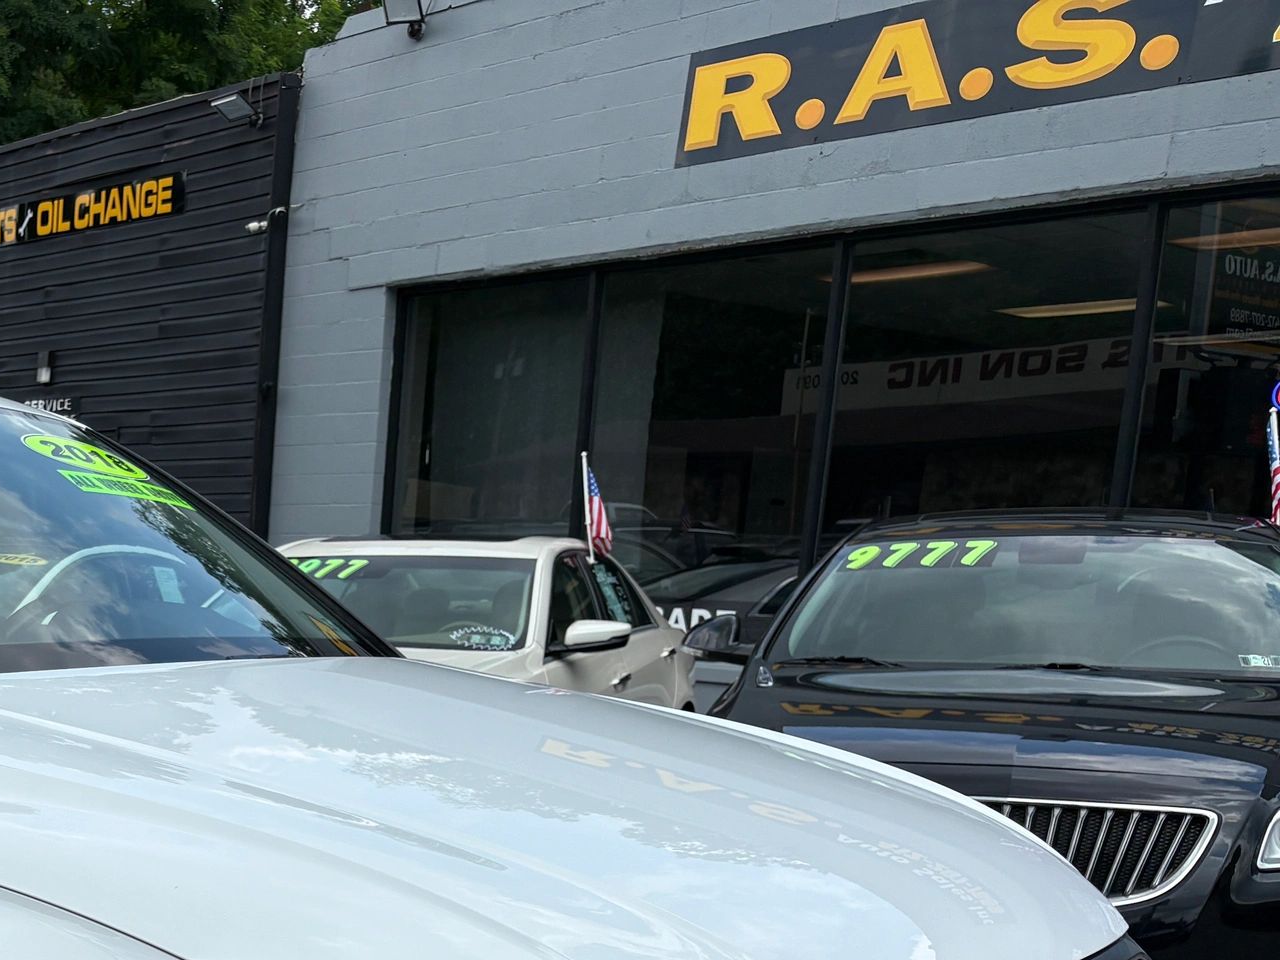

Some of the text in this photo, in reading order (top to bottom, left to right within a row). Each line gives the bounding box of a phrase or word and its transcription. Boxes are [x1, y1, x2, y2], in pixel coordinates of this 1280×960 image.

[683, 0, 1180, 152] R.A.S.
[36, 199, 70, 236] OIL
[74, 177, 174, 230] CHANGE
[846, 540, 998, 570] 9777
